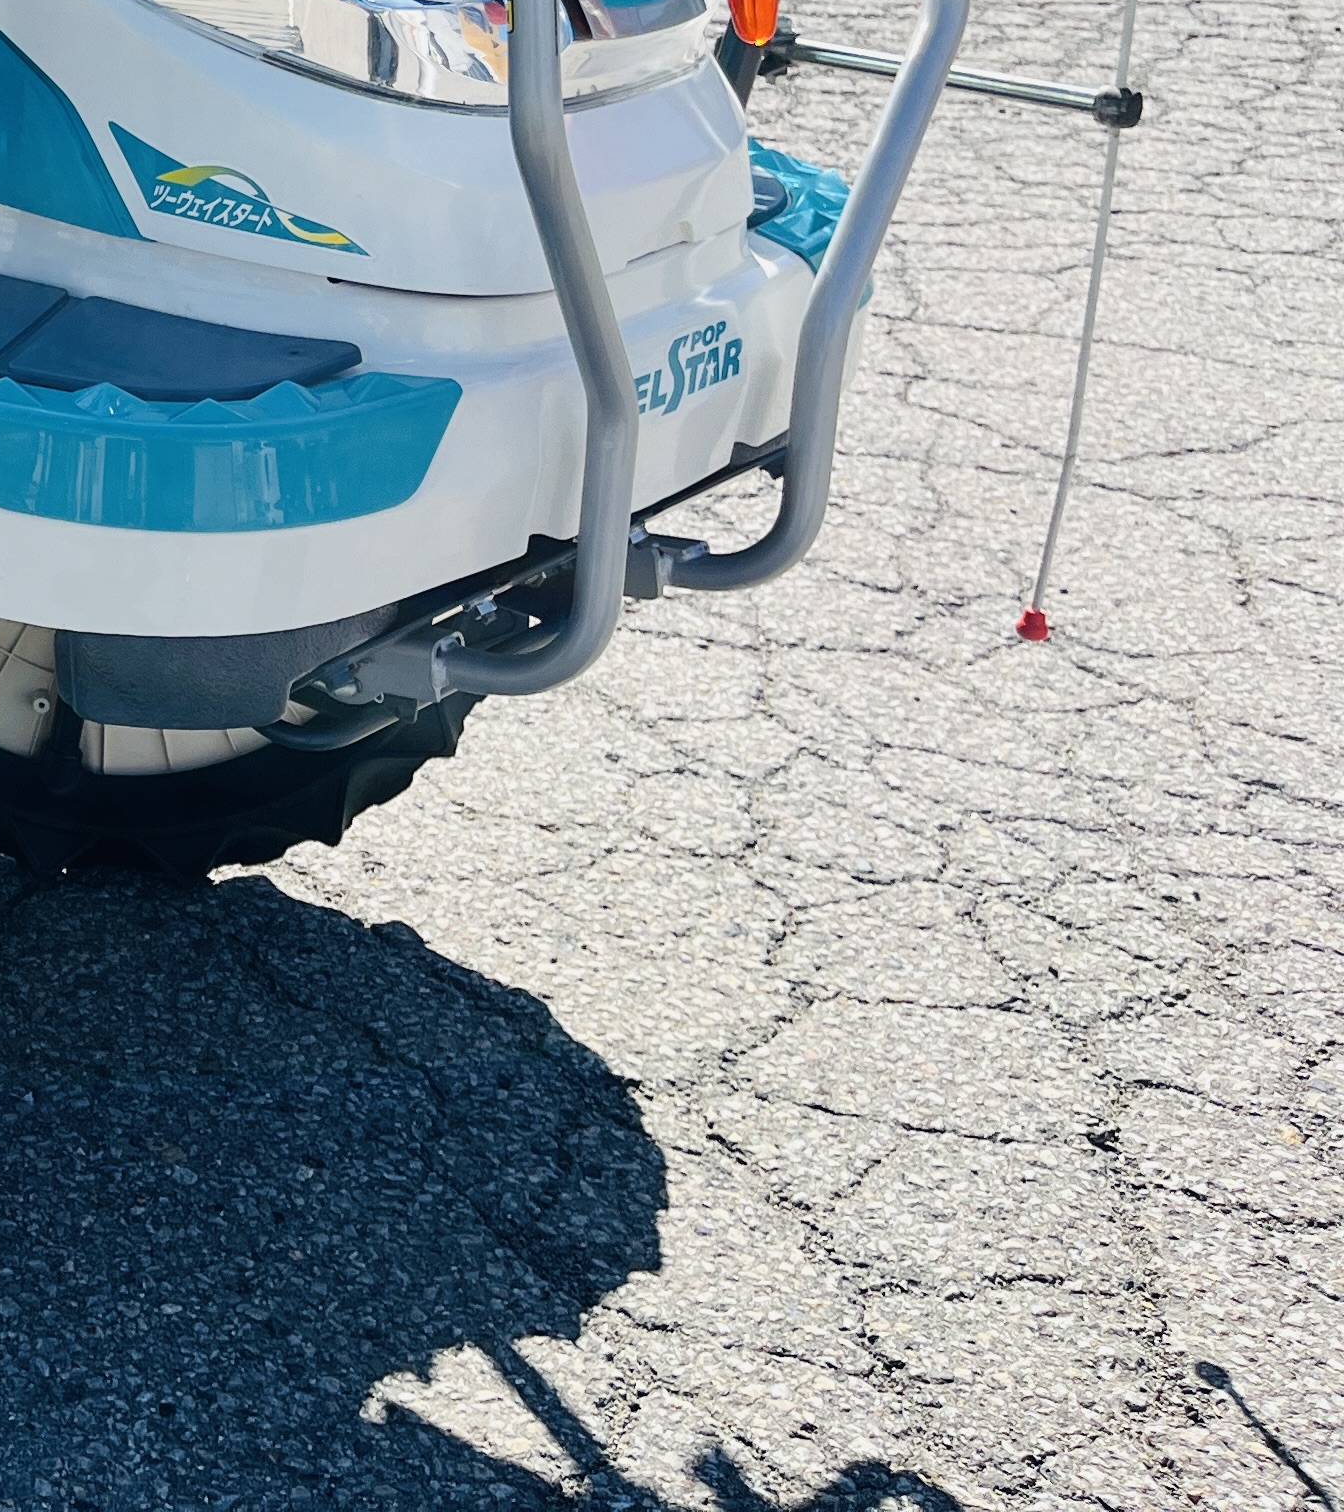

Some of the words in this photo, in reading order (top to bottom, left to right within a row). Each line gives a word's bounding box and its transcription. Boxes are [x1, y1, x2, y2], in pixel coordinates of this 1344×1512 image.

[150, 184, 273, 232] ツーウェイスタート
[690, 320, 727, 351] POP
